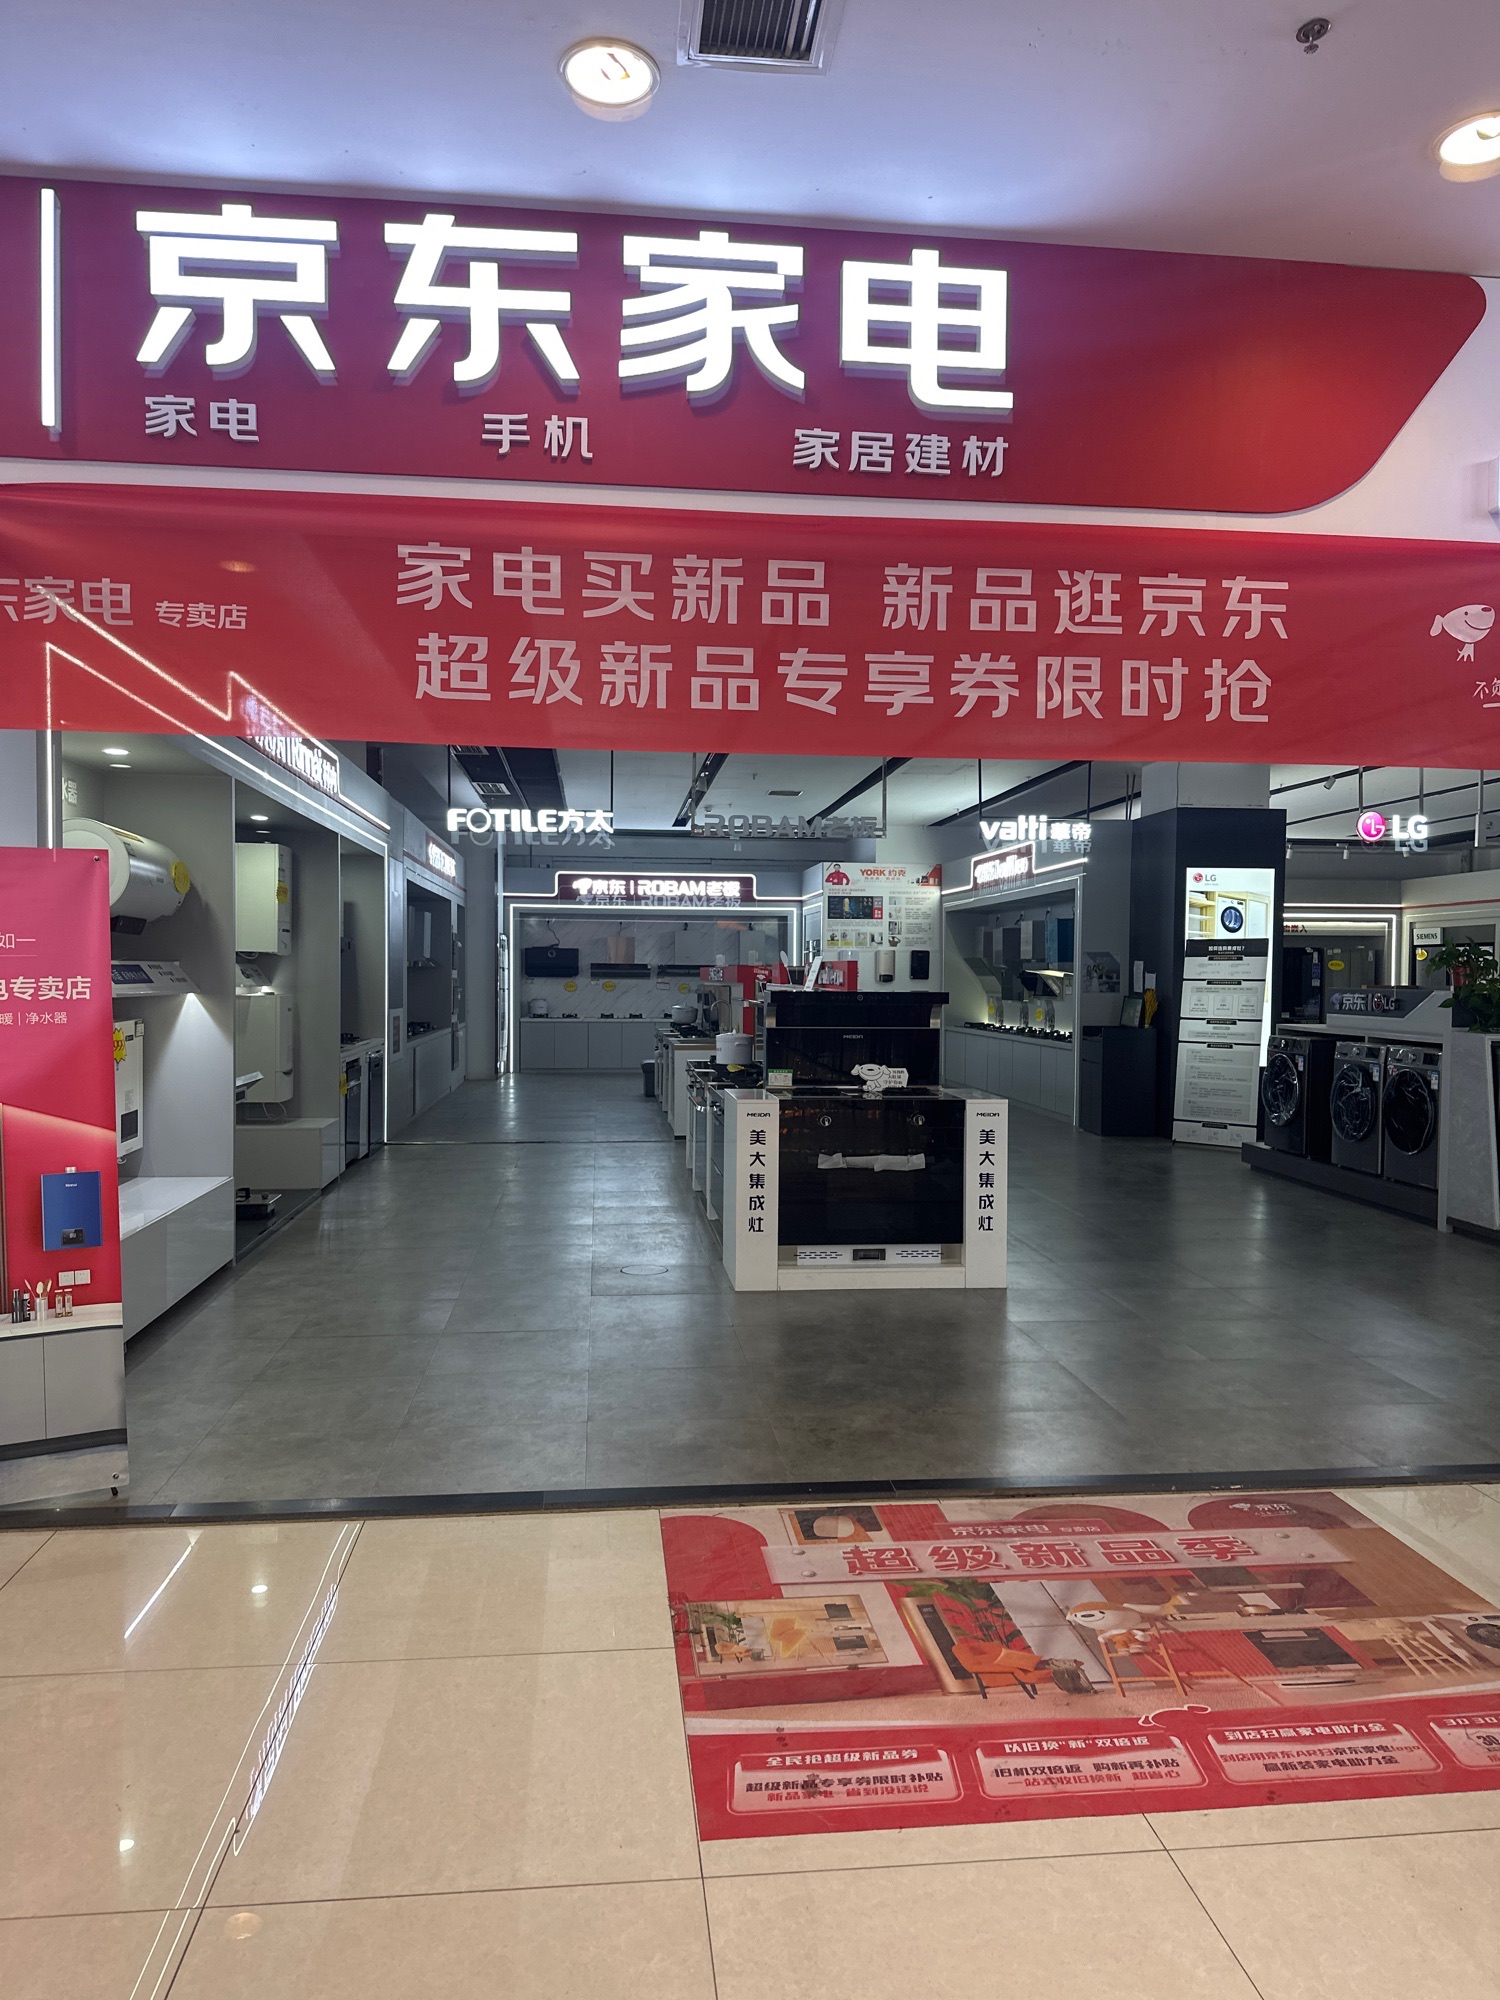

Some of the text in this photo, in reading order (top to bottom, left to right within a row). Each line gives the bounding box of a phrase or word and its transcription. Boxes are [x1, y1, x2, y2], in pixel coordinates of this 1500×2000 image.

[135, 203, 1013, 411] 京东家电
[145, 395, 259, 443] 家电
[481, 412, 593, 460] 手机
[792, 428, 1009, 478] 家居建材
[396, 542, 1290, 641] 家电买新品 新品逛京东
[154, 600, 248, 630] 专卖店
[415, 632, 1273, 723] 超级新品专享券限时抢
[1392, 815, 1428, 839] LG
[26, 1012, 67, 1024] 净水器
[1342, 993, 1396, 1010] 京东 LG
[748, 1129, 766, 1233] 美大集成灶
[978, 1128, 996, 1231] 美大集成灶
[951, 1523, 1052, 1537] 京东家电
[842, 1535, 1259, 1576] 超级新品季
[1223, 1722, 1388, 1741] 到店扫赢家电助力金
[765, 1748, 919, 1767] 全民抢超级新品券
[1092, 1758, 1180, 1773] 购新再补贴
[745, 1772, 944, 1793] 超级新品专享券限时补贴
